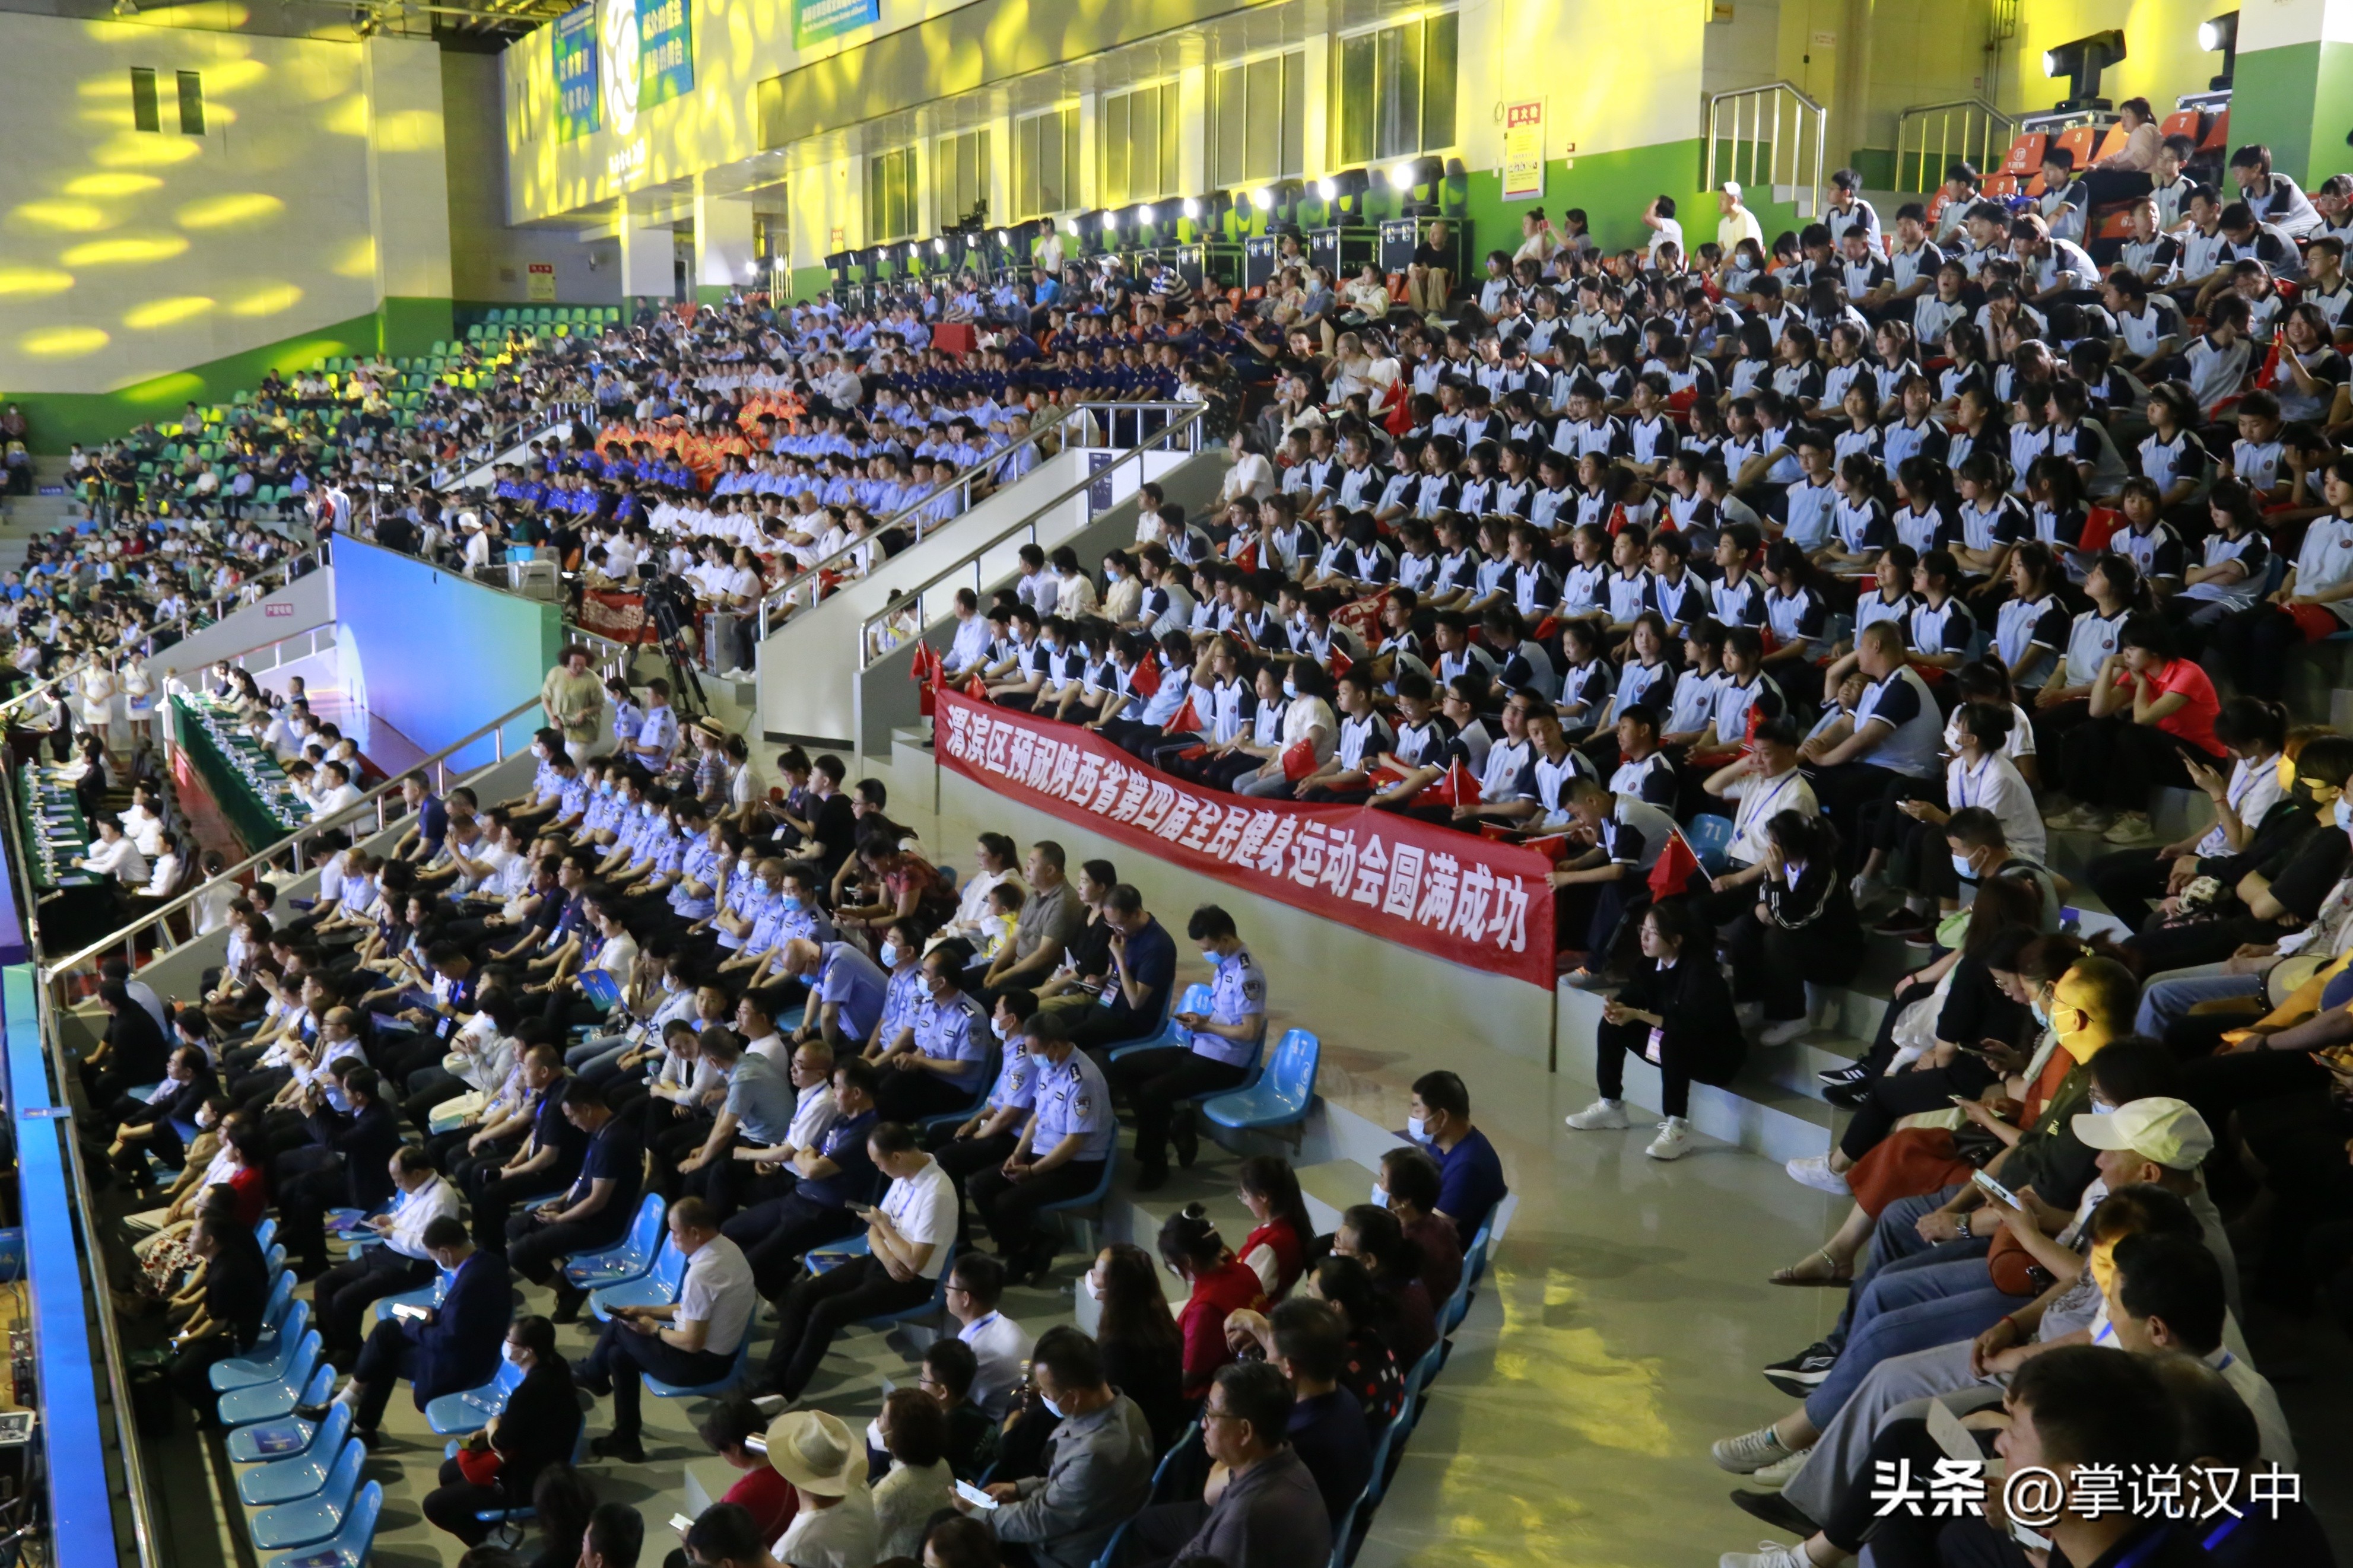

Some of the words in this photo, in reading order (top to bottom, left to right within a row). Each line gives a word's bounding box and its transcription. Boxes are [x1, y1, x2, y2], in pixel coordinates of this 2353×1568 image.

[2179, 117, 2187, 128] 7
[2074, 132, 2082, 142] 3
[946, 704, 1529, 952] 渭滨区预祝陕西省第四届全民健身运动会圆满成功
[1705, 822, 1722, 841] 71
[1291, 1038, 1308, 1057] 47
